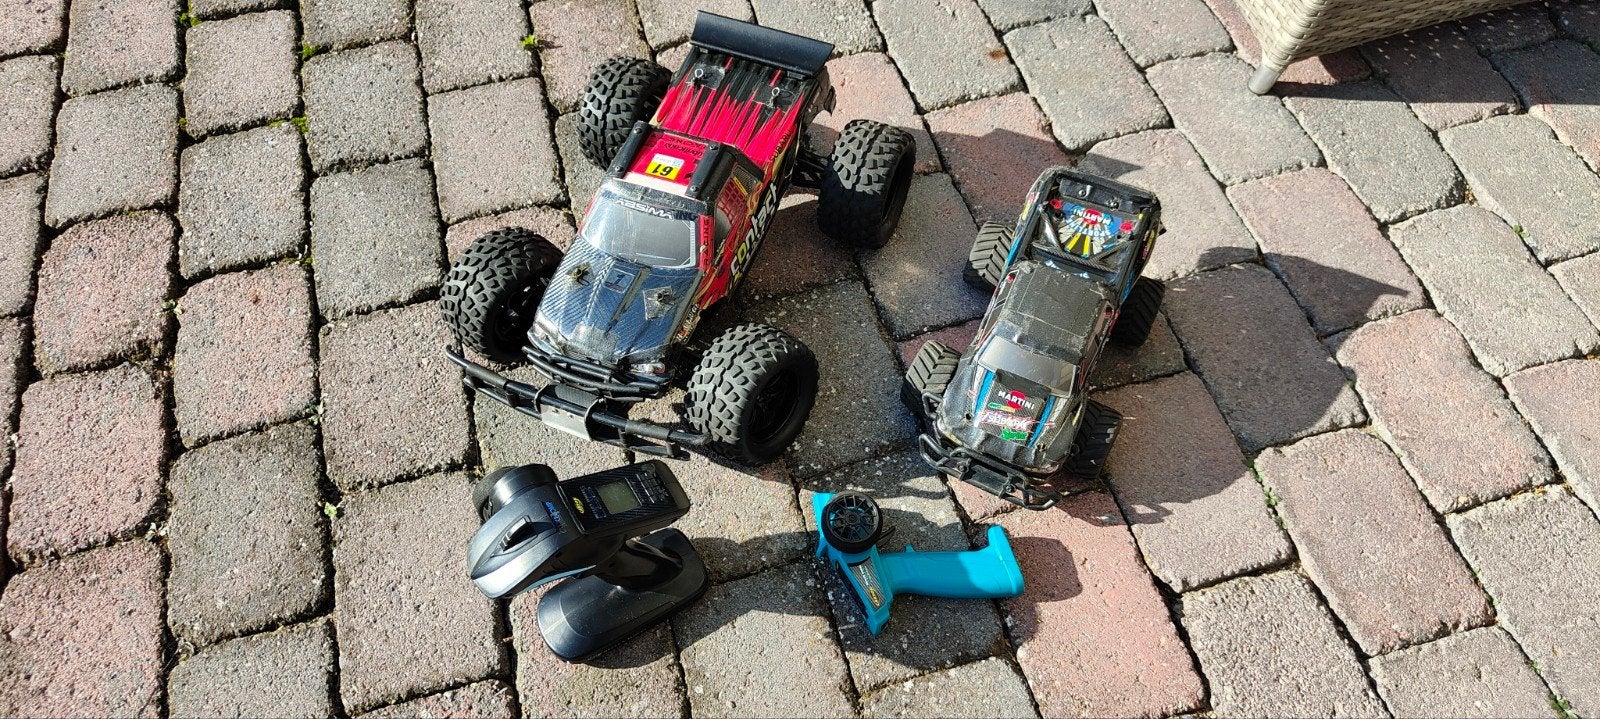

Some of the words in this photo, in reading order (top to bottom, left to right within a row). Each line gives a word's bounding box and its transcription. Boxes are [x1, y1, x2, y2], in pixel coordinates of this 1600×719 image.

[651, 164, 674, 177] 61
[1073, 208, 1111, 226] MARTINI
[730, 182, 778, 277] contact
[998, 390, 1035, 411] MARTINI
